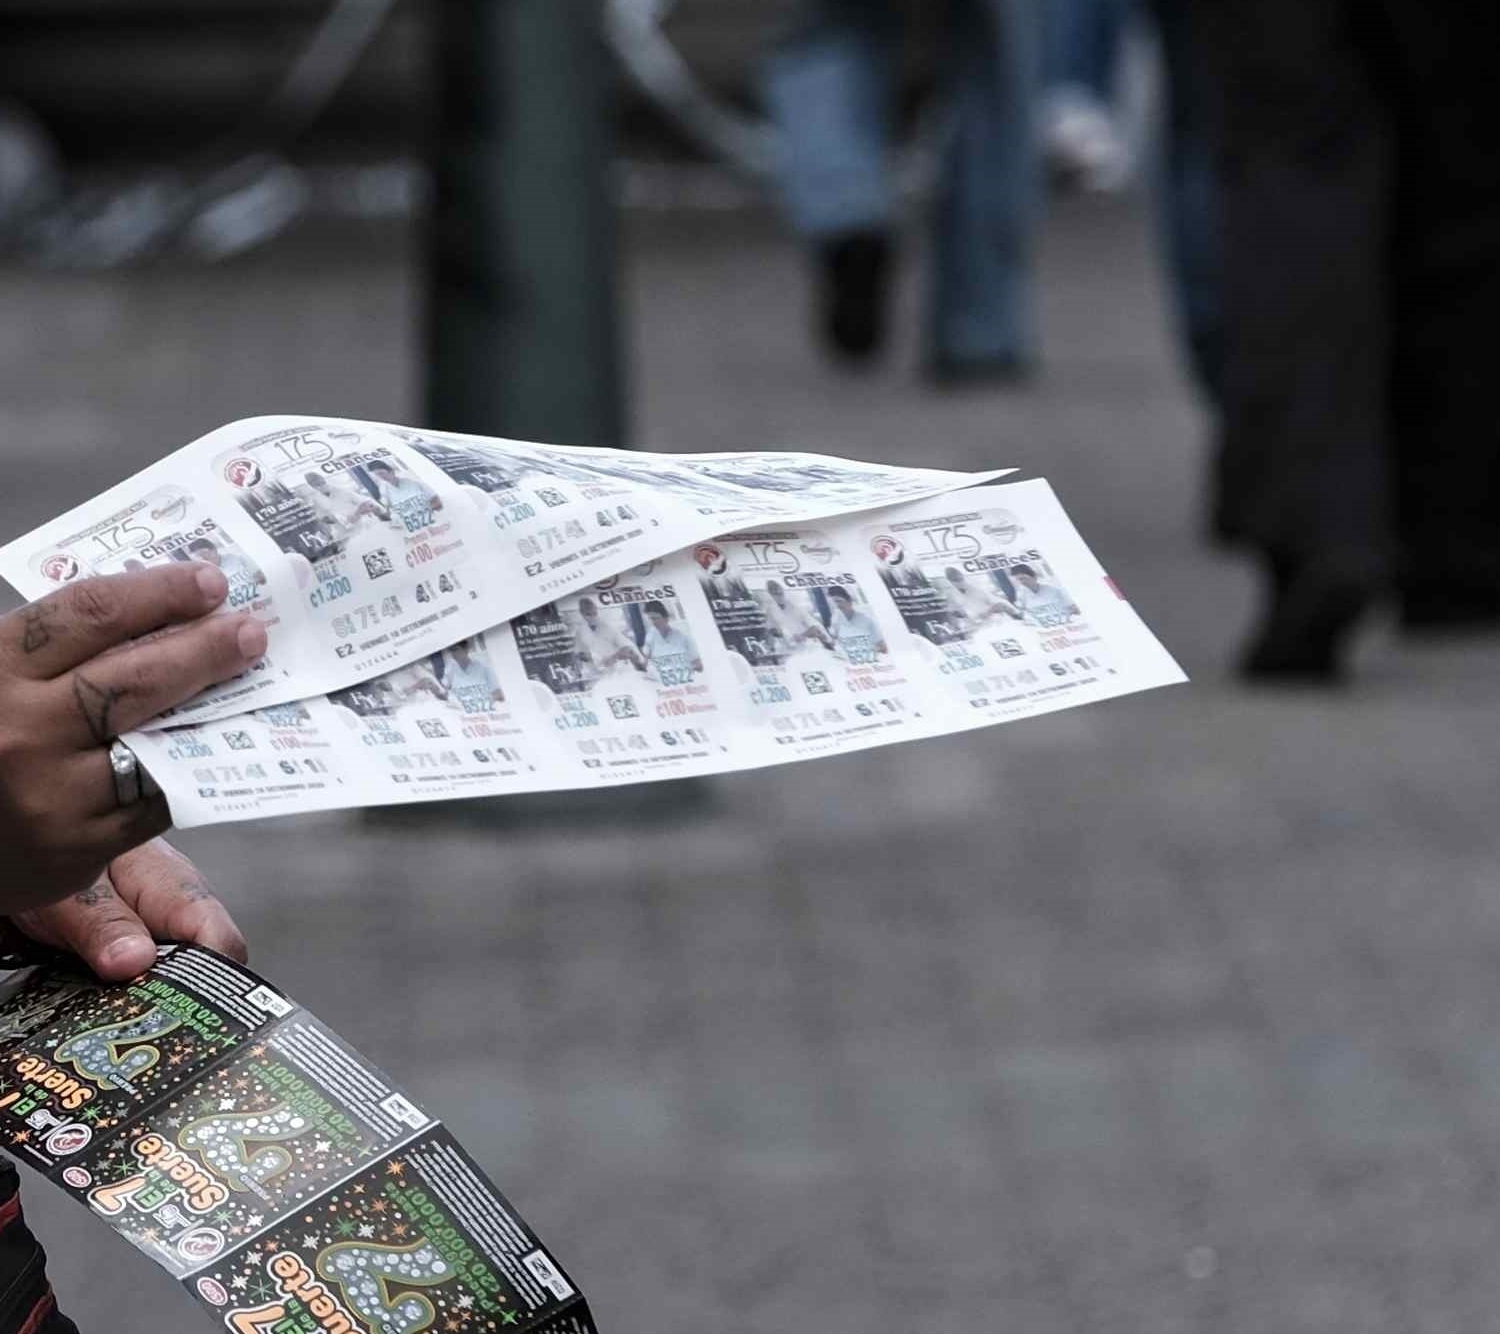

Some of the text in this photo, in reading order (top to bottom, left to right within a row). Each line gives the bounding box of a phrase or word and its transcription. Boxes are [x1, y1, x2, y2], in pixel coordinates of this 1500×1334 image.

[274, 432, 334, 463] 175
[320, 446, 394, 475] ChanceS
[403, 508, 435, 533] 6522
[524, 561, 545, 577] E2
[598, 584, 677, 606] ChanceS
[515, 625, 538, 638] 170
[335, 643, 356, 659] E2
[659, 667, 695, 687] 6522
[16, 1056, 95, 1110] Suerte
[135, 1136, 226, 1208] Suerte
[93, 1180, 164, 1210] El 7
[383, 1180, 421, 1222] hasta
[417, 1219, 458, 1262] ganar
[282, 1297, 316, 1332] de la
